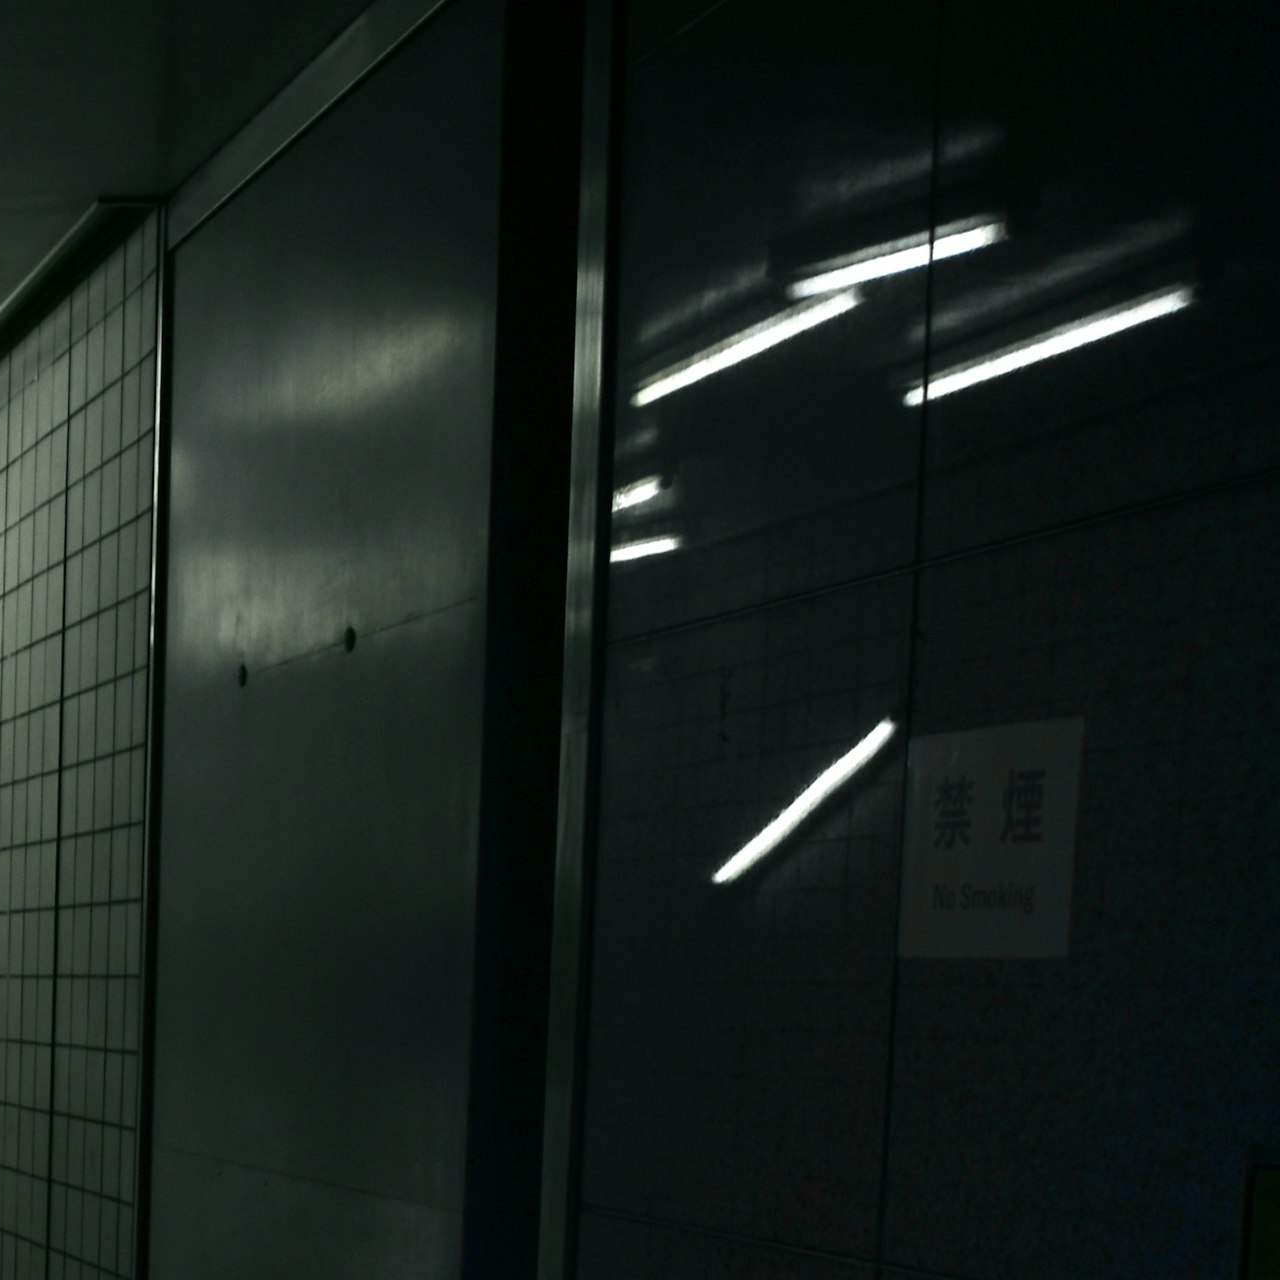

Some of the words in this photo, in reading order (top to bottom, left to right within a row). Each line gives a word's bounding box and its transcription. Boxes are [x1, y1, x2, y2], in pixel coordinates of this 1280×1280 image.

[933, 769, 1048, 851] 禁煙
[932, 883, 957, 911] No
[960, 881, 1037, 915] Smoking
